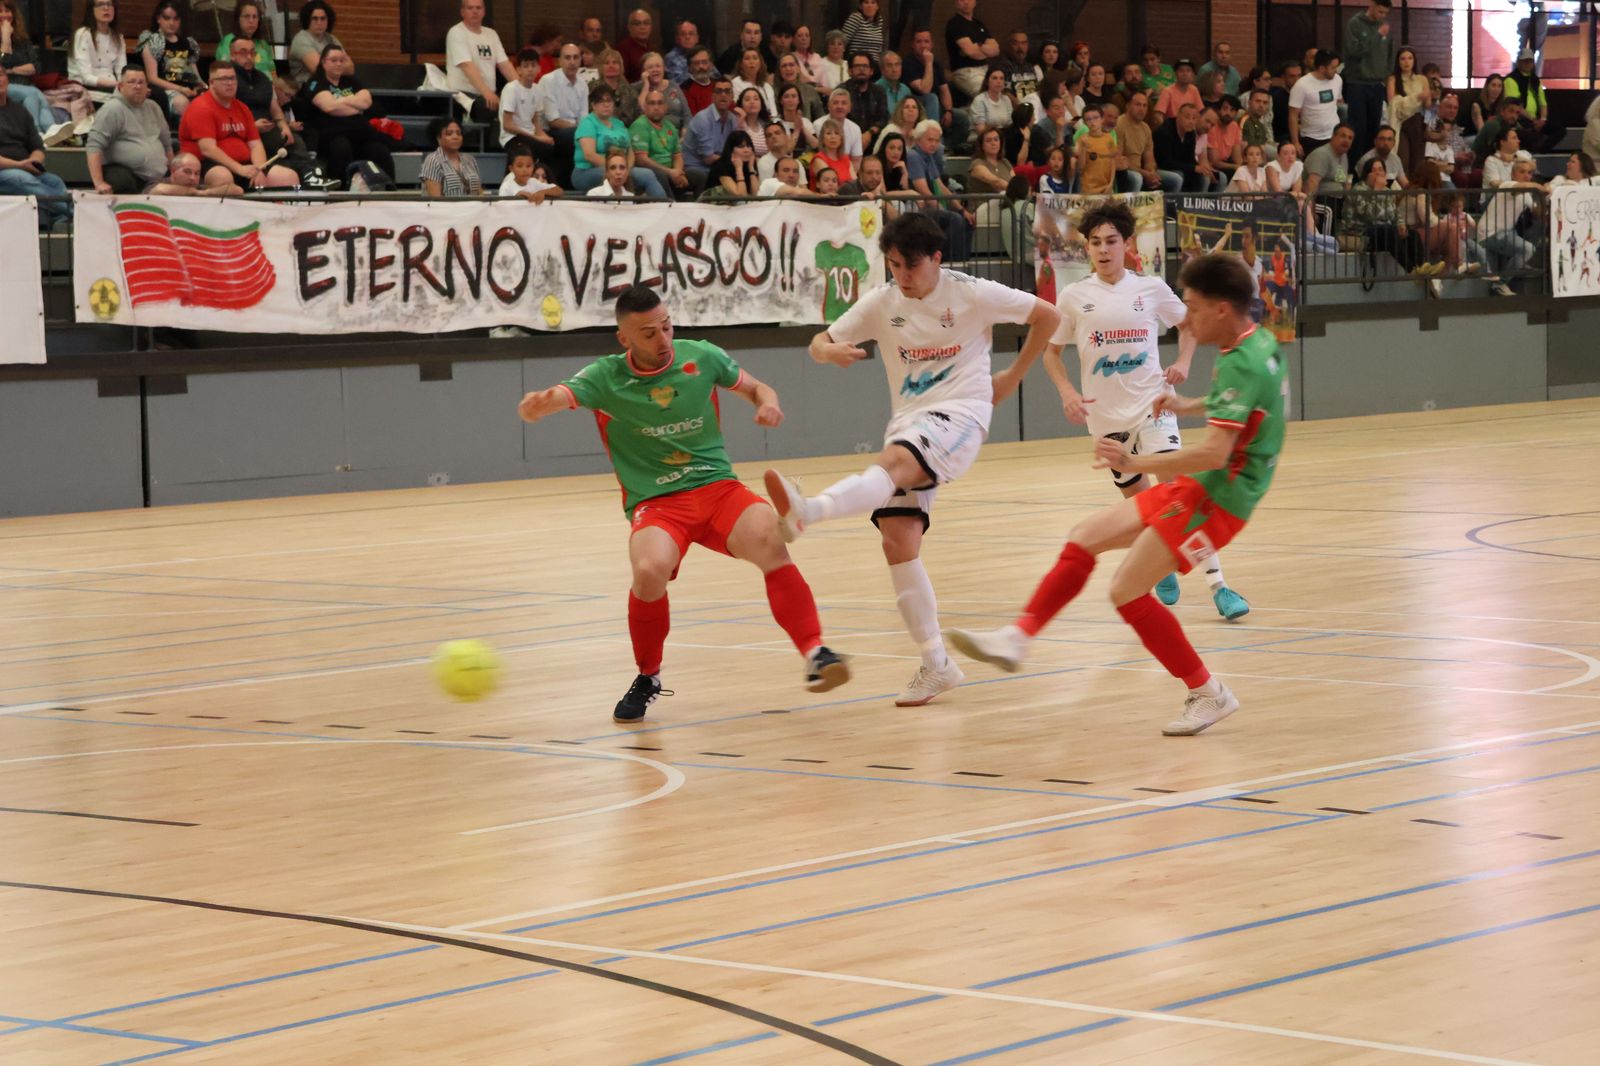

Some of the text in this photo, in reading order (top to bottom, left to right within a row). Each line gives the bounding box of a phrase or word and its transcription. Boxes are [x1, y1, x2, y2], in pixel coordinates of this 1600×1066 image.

[1183, 197, 1253, 213] EL DIOS VELASCO
[293, 218, 801, 308] ETERNO VELASCO!!
[828, 266, 854, 302] 10
[1104, 329, 1149, 340] TUBANOR
[641, 417, 703, 436] euronics
